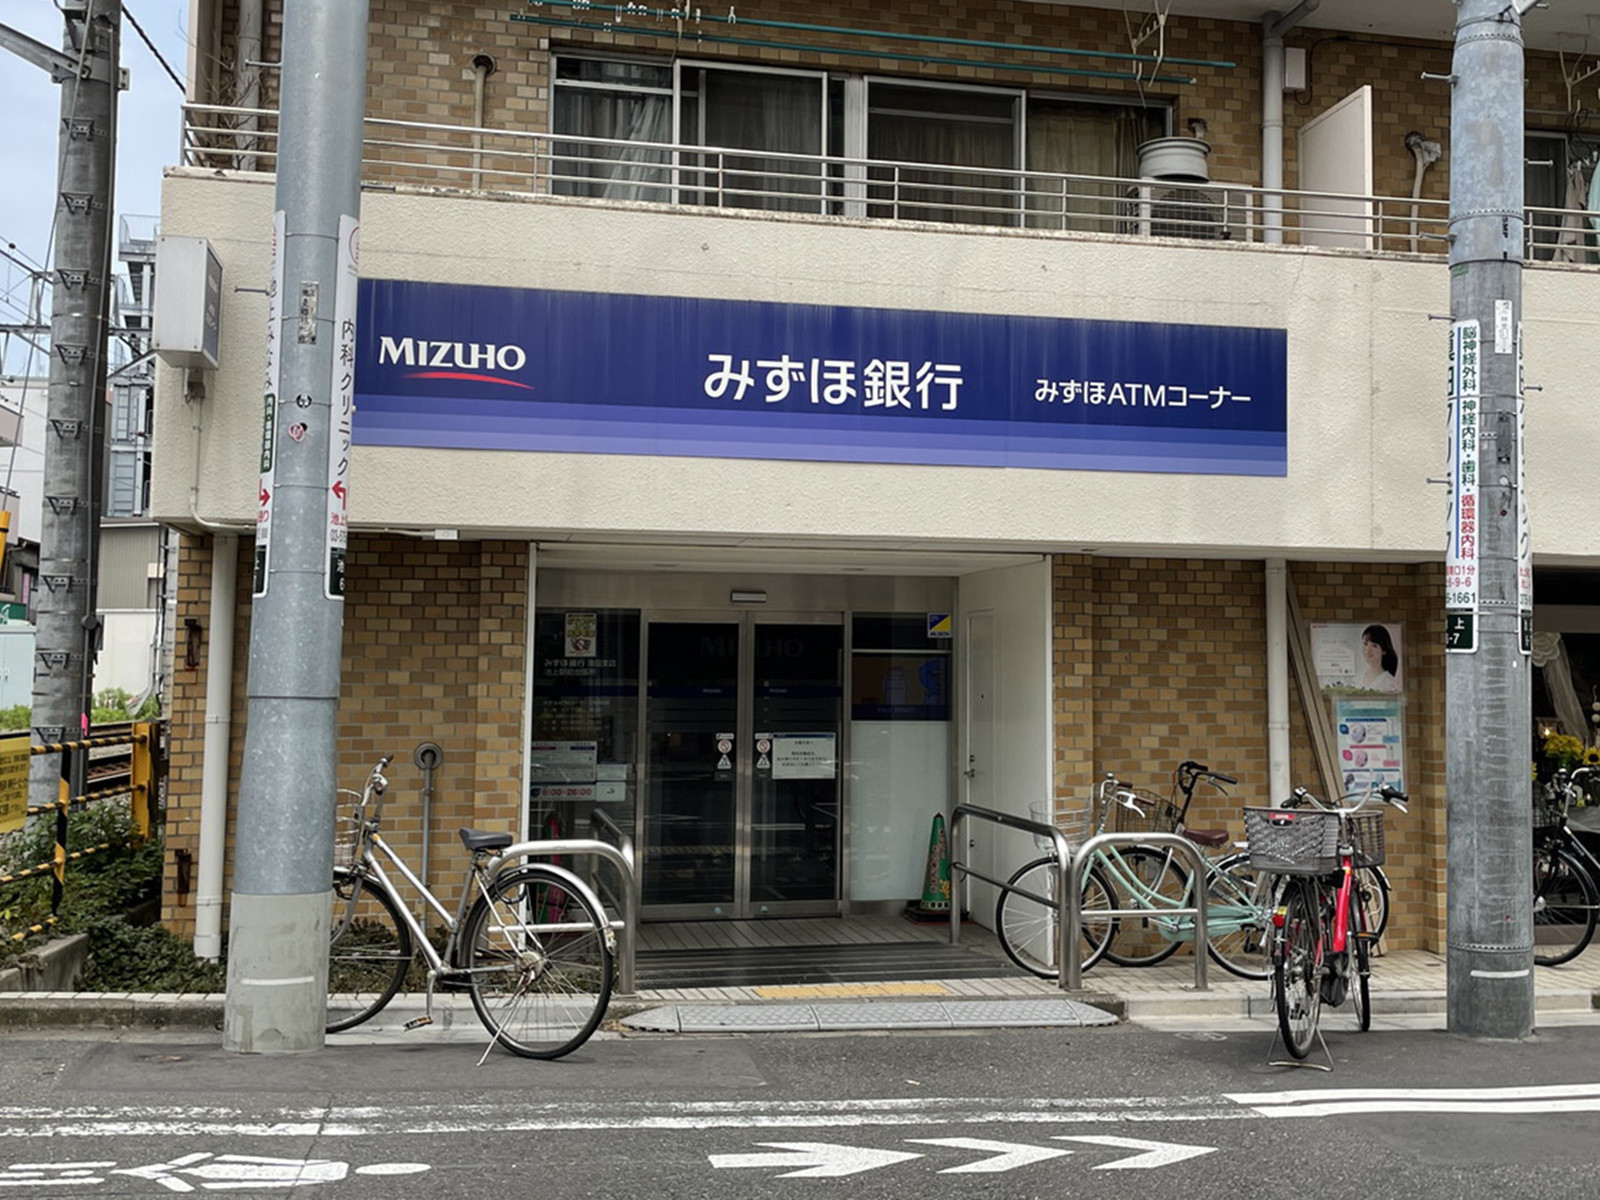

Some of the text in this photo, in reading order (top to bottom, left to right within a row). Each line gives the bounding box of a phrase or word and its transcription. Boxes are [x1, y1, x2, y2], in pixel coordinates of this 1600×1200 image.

[379, 336, 527, 370] MIZUHO
[338, 319, 354, 476] 内科クリニック
[703, 354, 964, 411] みずほ銀行
[1035, 378, 1252, 410] みずほATMコーナー
[330, 512, 347, 526] 池上
